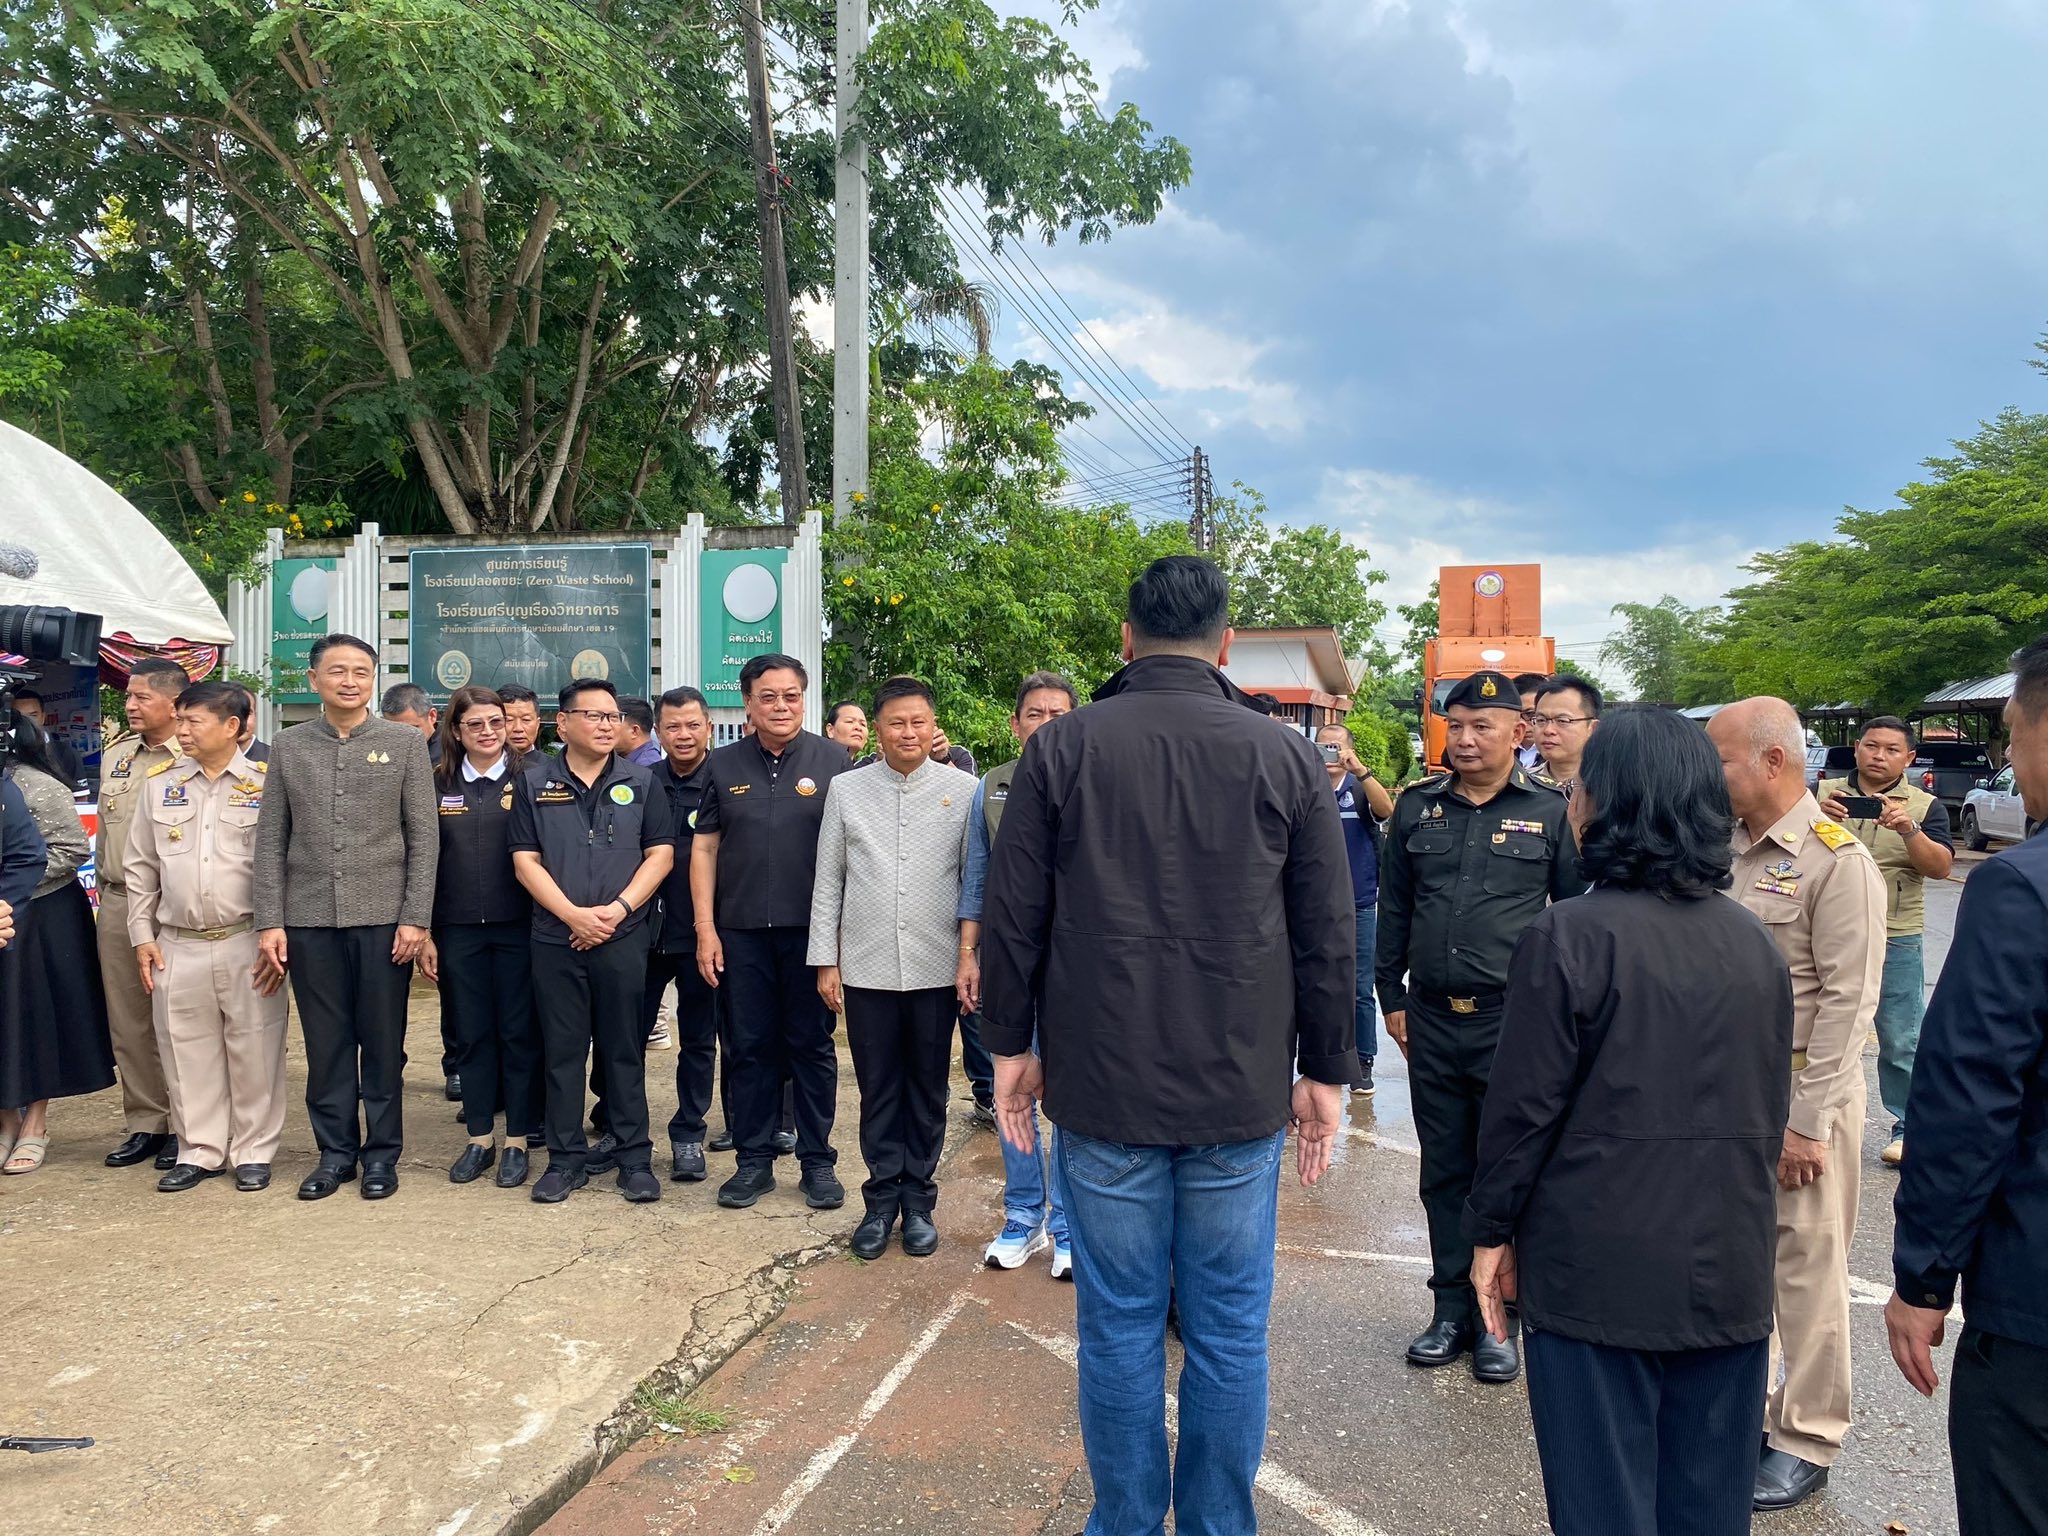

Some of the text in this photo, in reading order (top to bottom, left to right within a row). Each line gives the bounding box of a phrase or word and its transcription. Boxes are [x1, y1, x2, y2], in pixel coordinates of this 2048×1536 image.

[486, 556, 568, 573] ศูนย์การเรียนรู้
[424, 573, 634, 588] โรงเรียนปลอดขยะ (Zero Waste School)
[436, 601, 620, 620] โรงเรียนศรีบุญเรืองวิทยาคาร
[728, 629, 774, 644] คิดก่อนใช้
